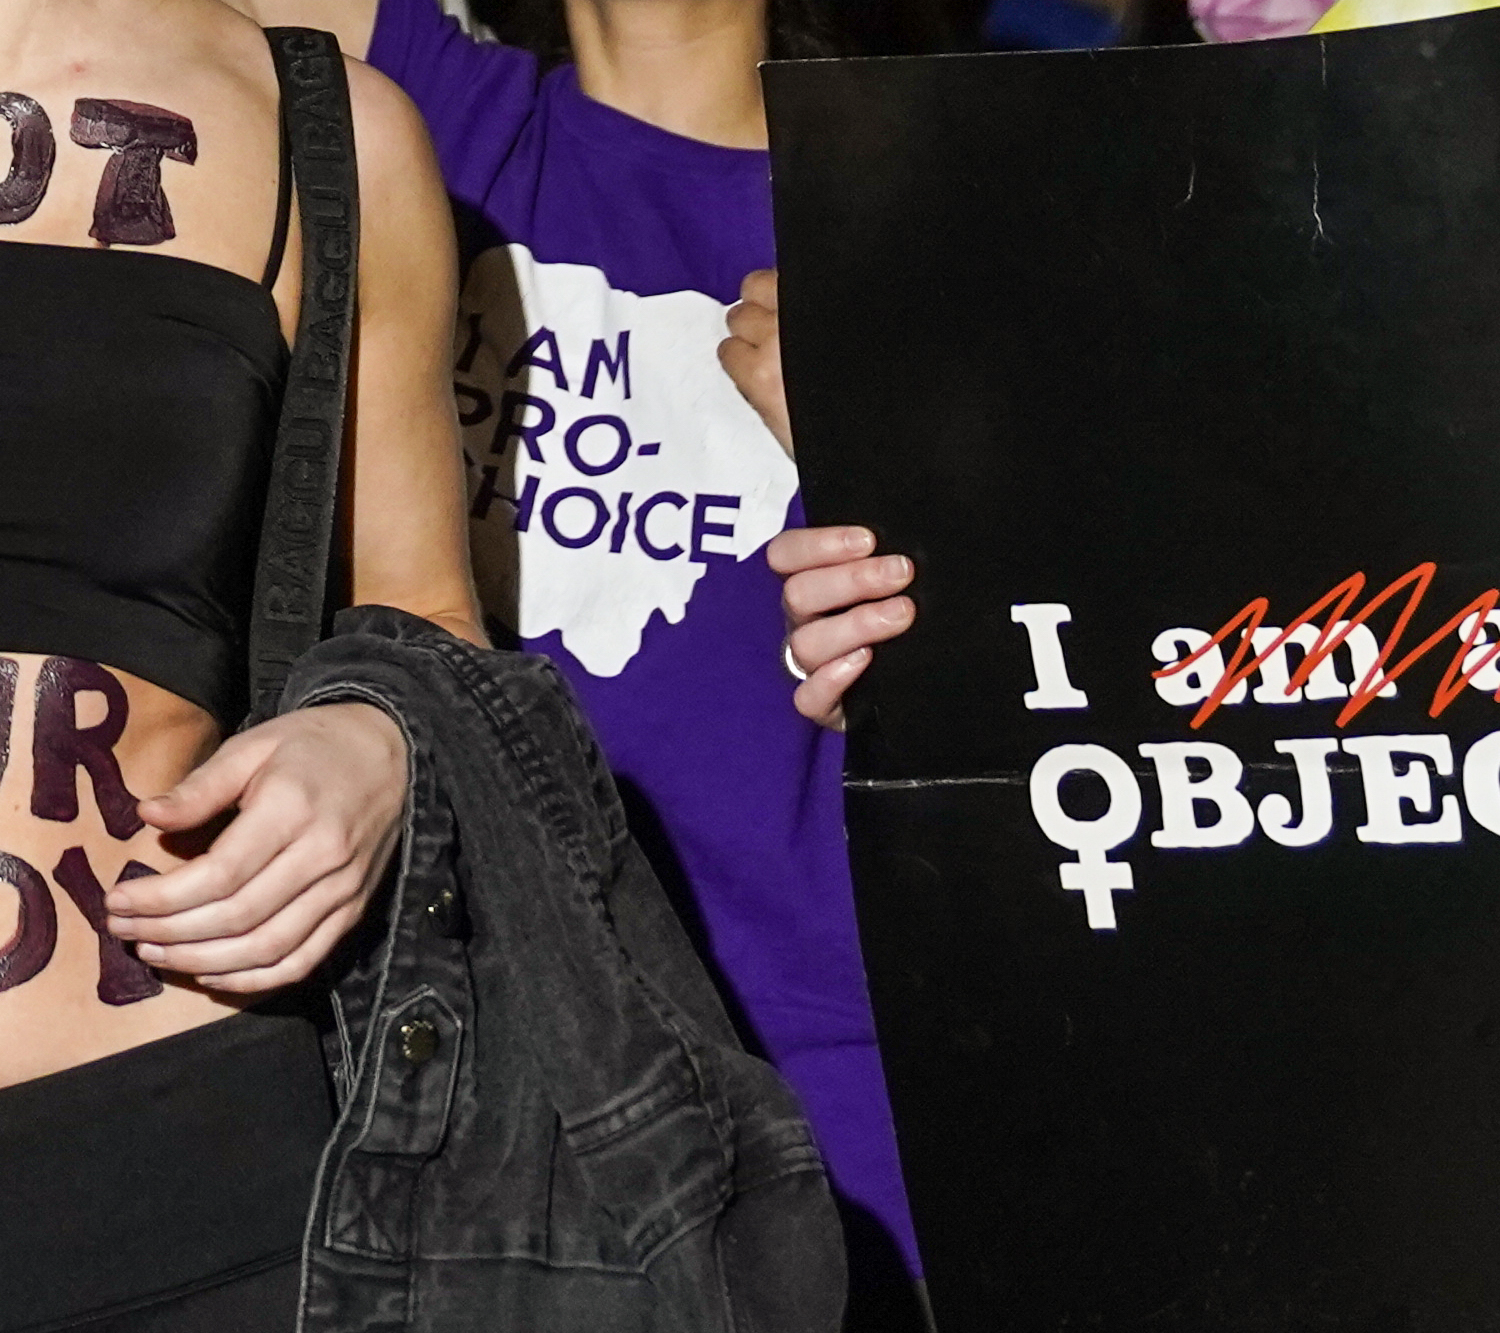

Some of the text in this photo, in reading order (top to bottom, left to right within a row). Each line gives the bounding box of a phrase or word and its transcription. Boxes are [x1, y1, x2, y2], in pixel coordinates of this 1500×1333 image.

[506, 326, 631, 400] AM
[464, 448, 741, 564] HOICE
[1010, 602, 1074, 710] I
